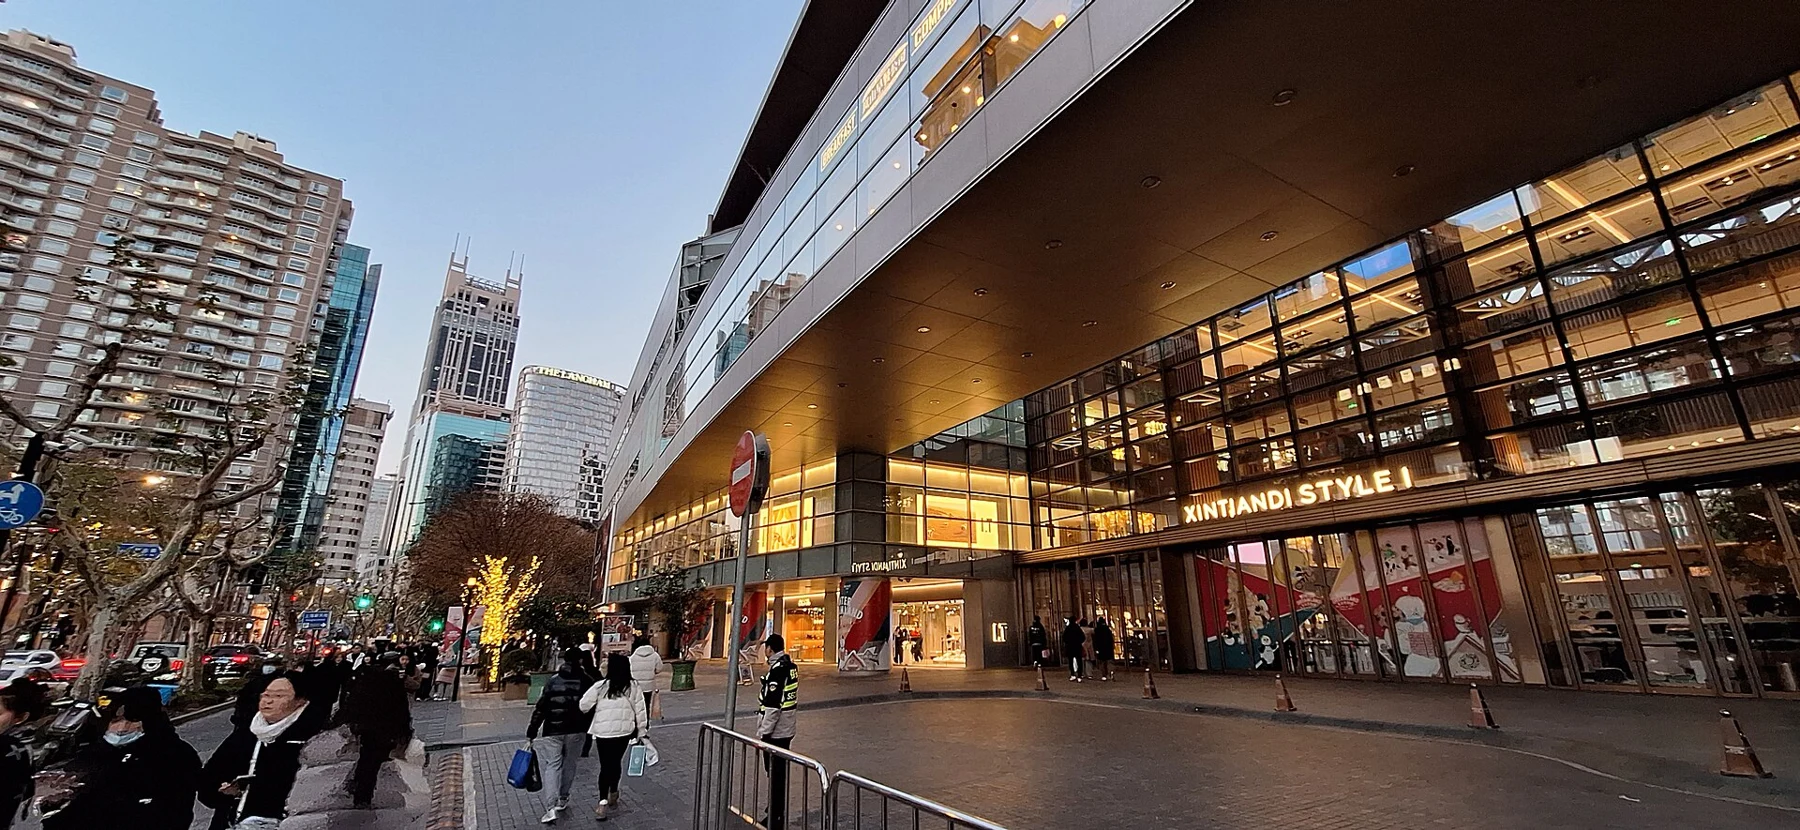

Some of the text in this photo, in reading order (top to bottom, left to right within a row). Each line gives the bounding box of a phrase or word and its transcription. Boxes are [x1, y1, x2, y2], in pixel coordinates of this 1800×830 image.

[822, 113, 857, 168] BREAKFAST
[539, 366, 560, 377] THE
[1184, 487, 1292, 524] XINTIANDI
[1299, 469, 1395, 505] STYLE
